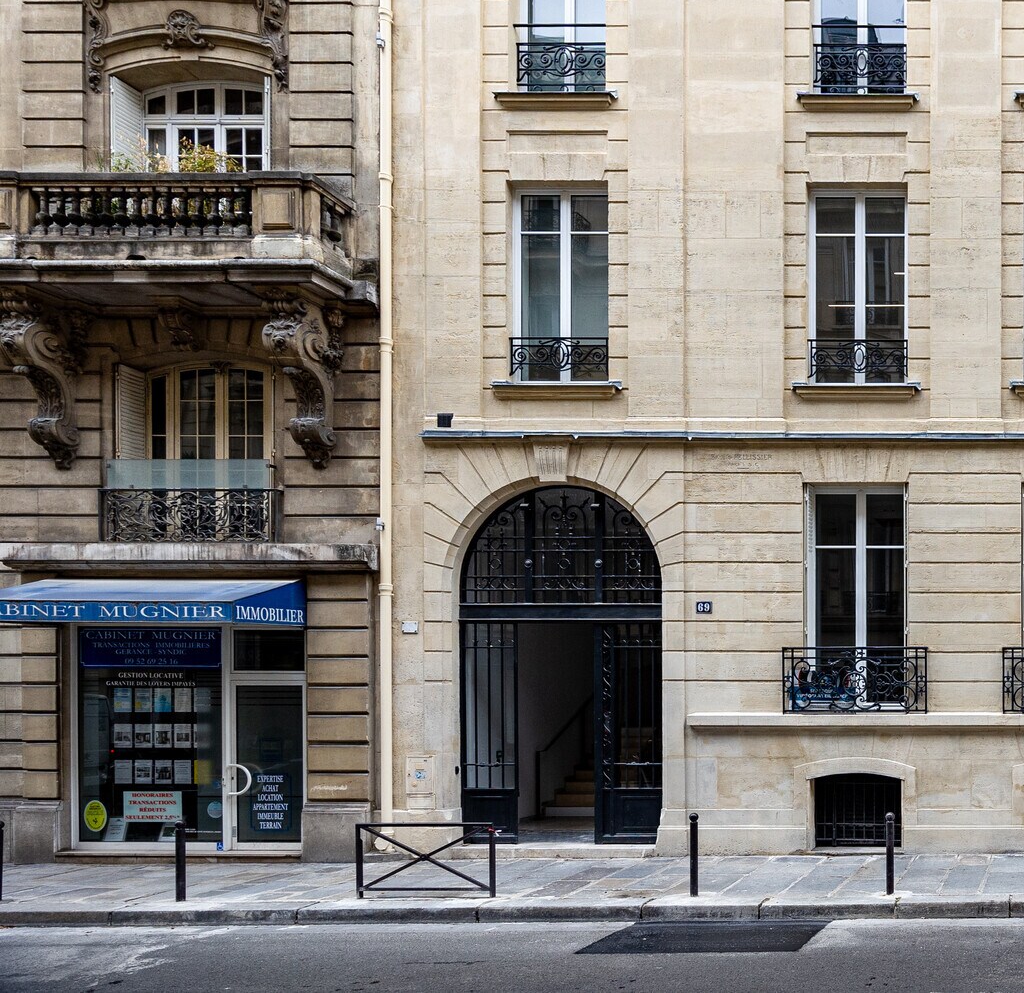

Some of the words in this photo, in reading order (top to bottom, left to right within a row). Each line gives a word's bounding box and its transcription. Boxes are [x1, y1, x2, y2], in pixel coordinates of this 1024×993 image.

[0, 604, 86, 617] BINET
[98, 605, 226, 618] MUGNIER
[697, 603, 710, 612] 69
[236, 605, 304, 623] IMMOBILIER
[86, 631, 145, 640] CABINET
[152, 631, 216, 640] MUGNIER
[257, 775, 284, 783] EXPERTISE
[252, 803, 289, 811] APPARTEMENT
[257, 812, 284, 820] IMMEUBLE
